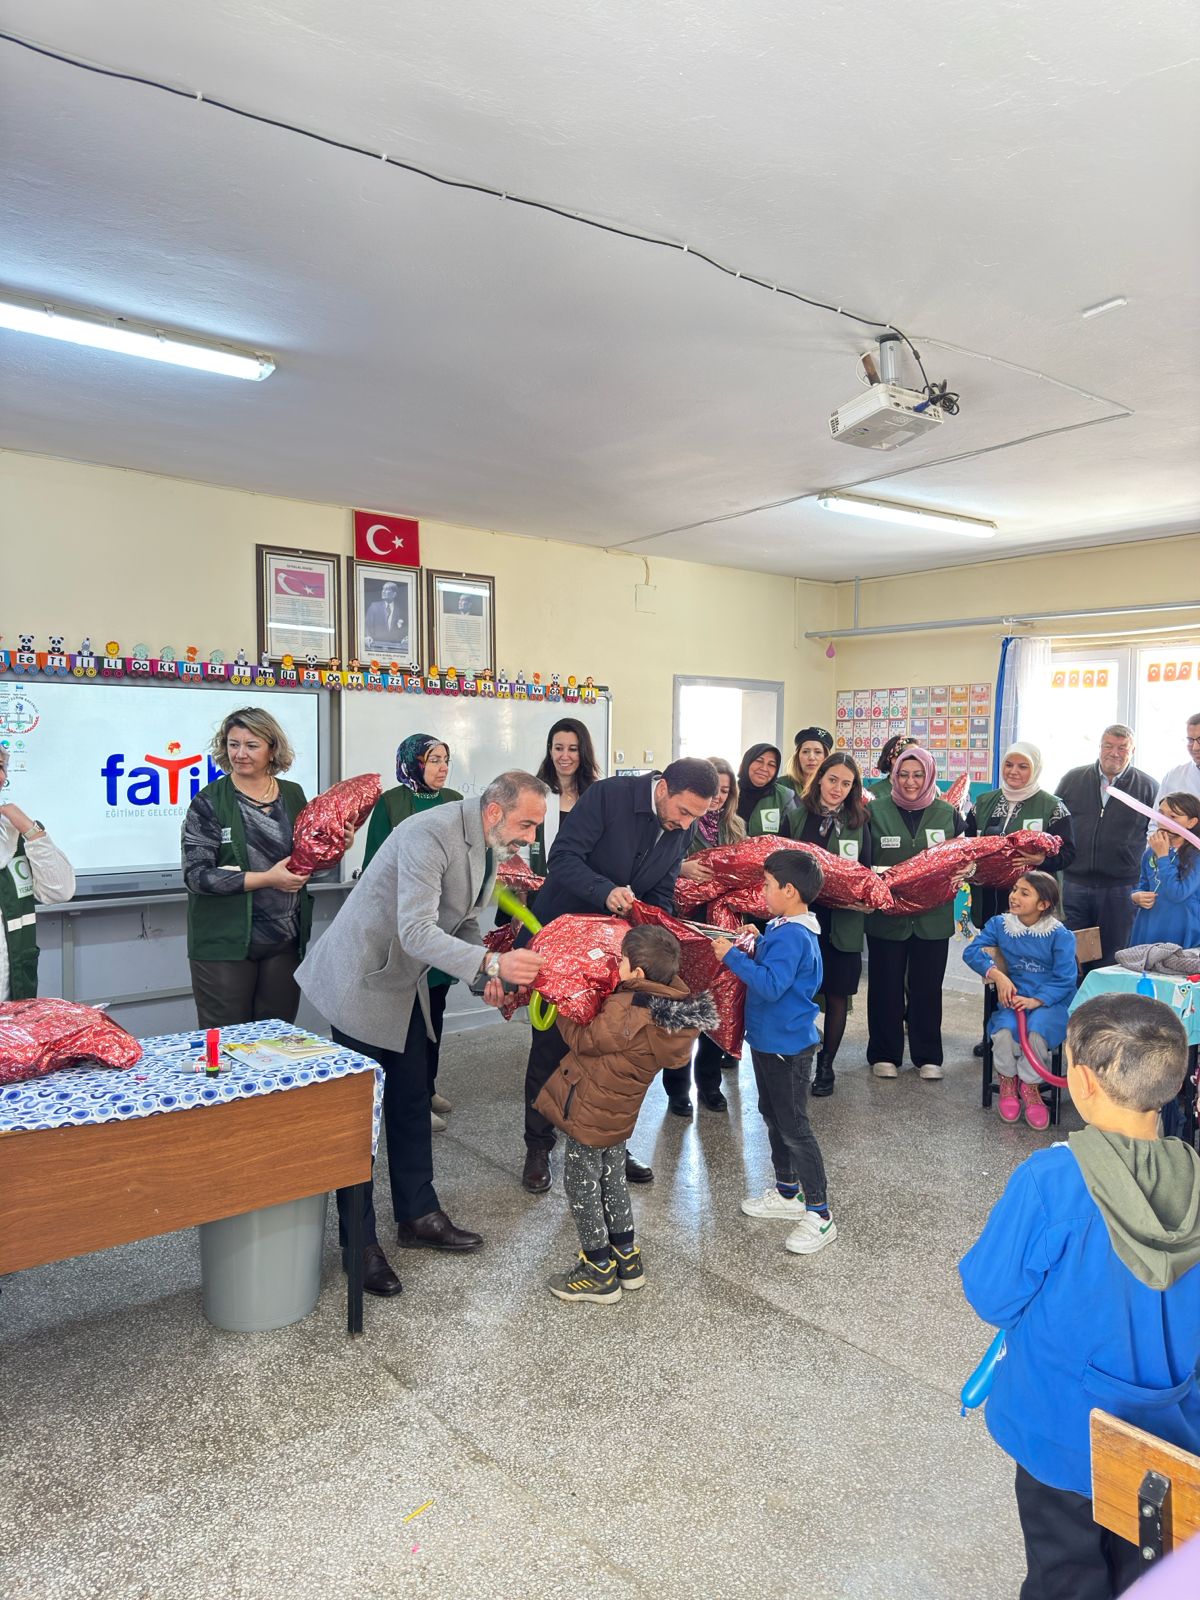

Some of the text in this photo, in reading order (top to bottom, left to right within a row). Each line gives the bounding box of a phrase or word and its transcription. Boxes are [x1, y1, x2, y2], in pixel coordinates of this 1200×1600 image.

[18, 654, 34, 664] Ee
[51, 657, 63, 666] Tt
[133, 661, 149, 670] Oo
[159, 663, 174, 672] Kk
[185, 665, 199, 673] Uu
[258, 669, 275, 678] Mm
[305, 672, 316, 680] Ss
[349, 675, 360, 684] Yy
[369, 676, 381, 684] Dd
